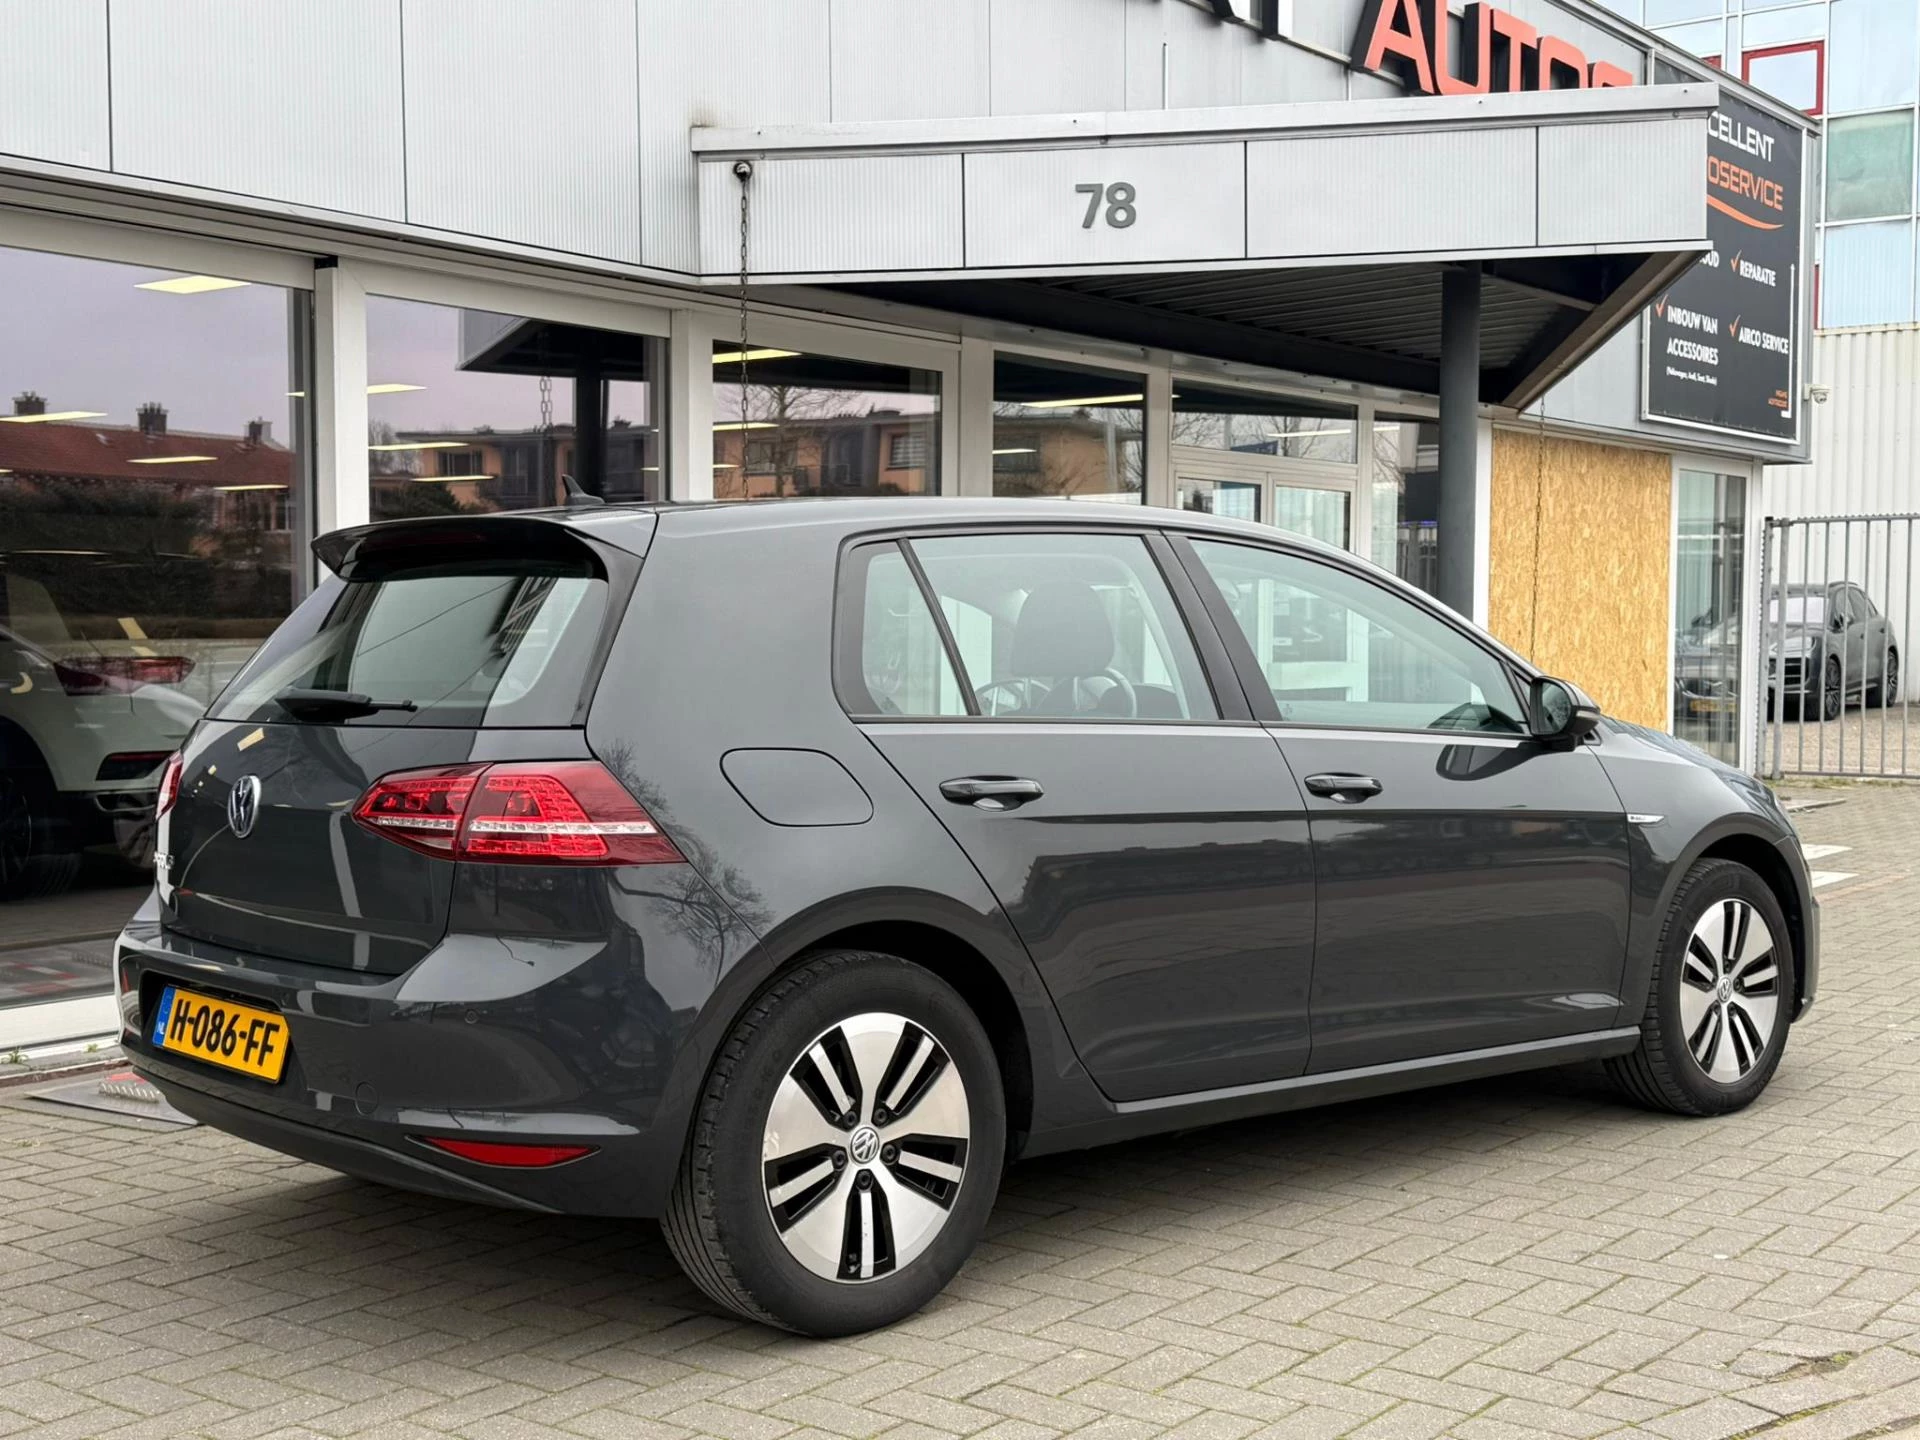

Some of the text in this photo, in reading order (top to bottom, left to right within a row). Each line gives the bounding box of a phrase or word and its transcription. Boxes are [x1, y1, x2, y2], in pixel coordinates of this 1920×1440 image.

[1075, 182, 1137, 229] 78
[1740, 259, 1776, 287] REPARATIE
[1667, 305, 1718, 335] INBOUW VAN
[1667, 337, 1719, 365] ACCESSOIRES
[1738, 326, 1789, 354] AIRCO SERVICE
[170, 998, 280, 1067] H-086-FF
